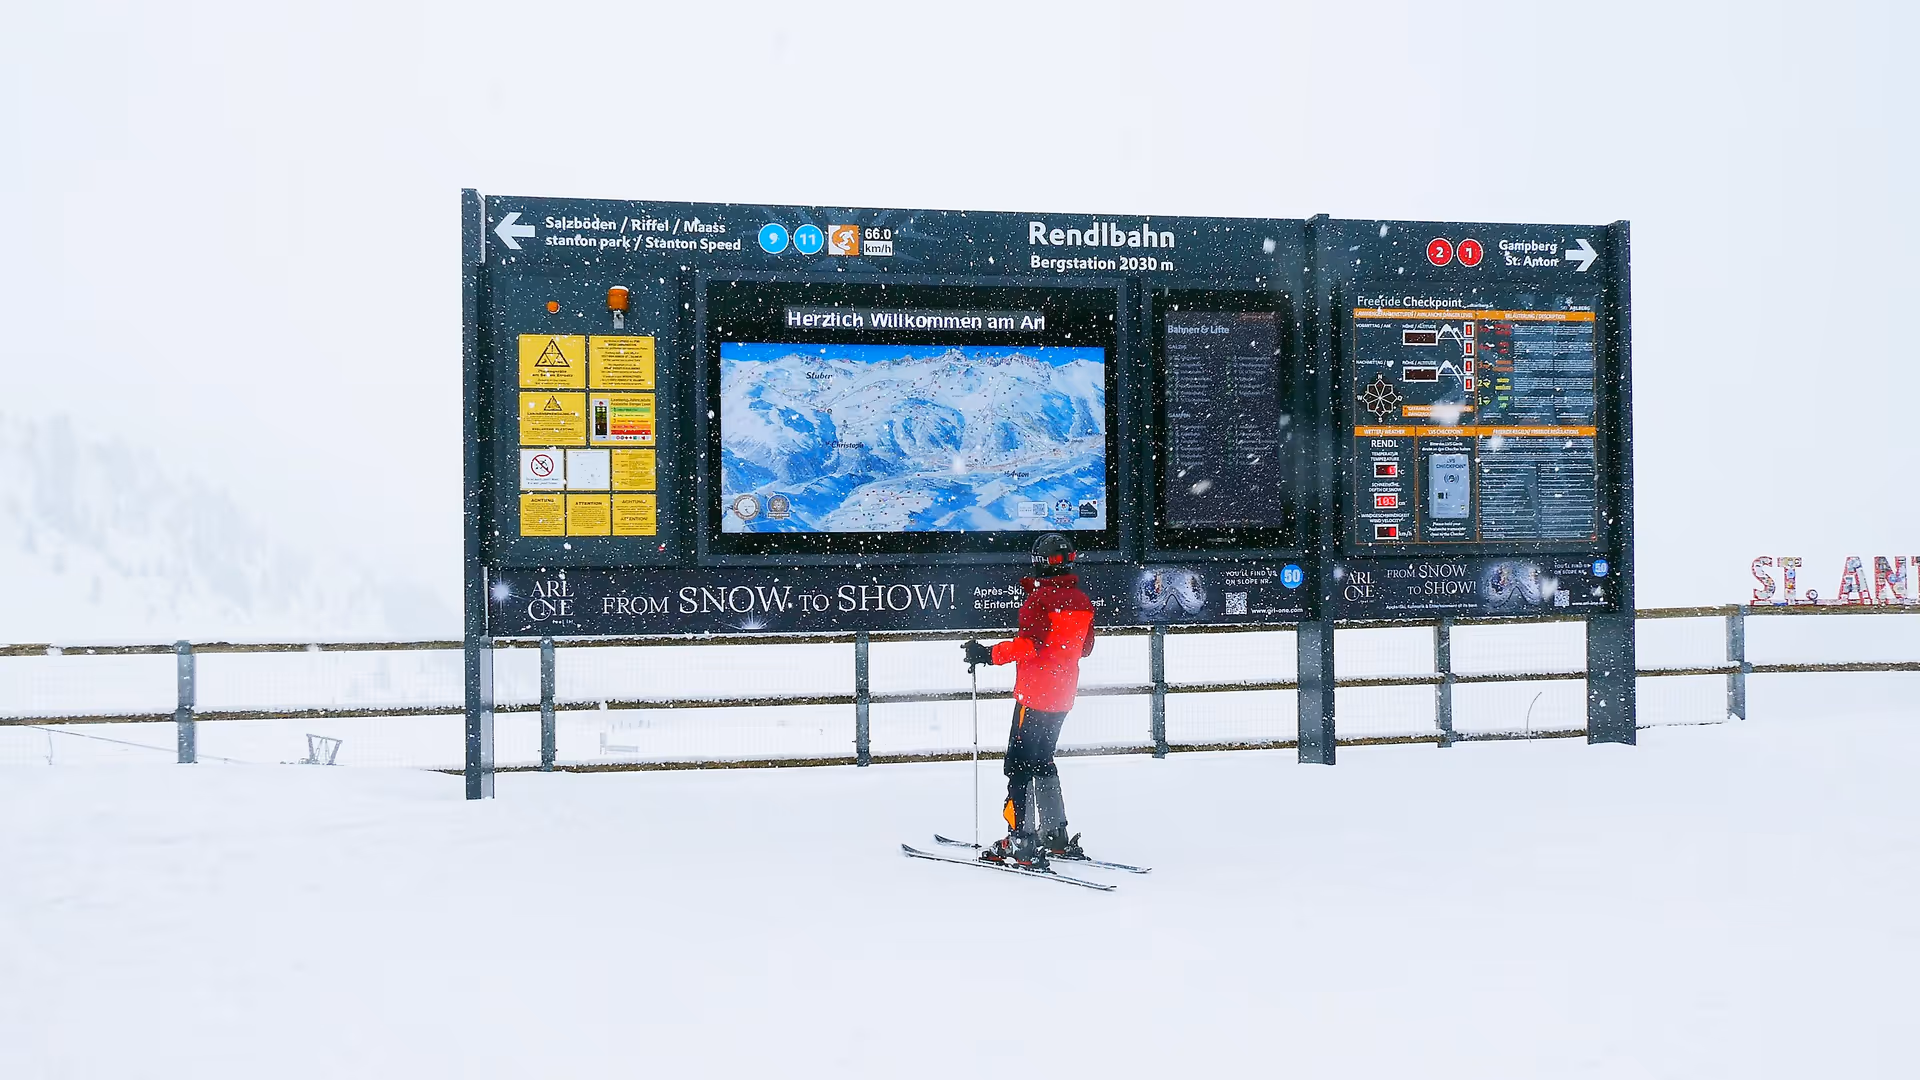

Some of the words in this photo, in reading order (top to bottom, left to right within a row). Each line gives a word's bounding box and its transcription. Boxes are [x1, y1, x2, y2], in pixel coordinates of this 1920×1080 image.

[545, 216, 617, 231] Salzböden
[631, 218, 669, 232] Riffel
[683, 219, 726, 234] Maass
[768, 231, 779, 245] 9
[799, 233, 816, 246] 11
[864, 228, 892, 240] 66.0
[1029, 221, 1175, 248] Rendlbahn
[545, 235, 597, 247] stanton
[600, 236, 631, 251] park
[645, 236, 697, 250] Stanton
[700, 239, 742, 253] Speed
[864, 243, 892, 255] km/h
[1498, 239, 1558, 255] Gampberg
[1435, 246, 1444, 258] 2
[1465, 247, 1473, 259] 1
[1030, 255, 1116, 272] Bergstation
[1119, 256, 1158, 271] 2030
[1160, 260, 1174, 271] m
[1504, 255, 1521, 267] St.
[1357, 296, 1400, 307] Freeride
[1403, 296, 1462, 309] Checkpoint
[787, 311, 864, 328] Herzlich
[870, 312, 982, 329] Willkommen
[987, 316, 1014, 330] am
[1200, 325, 1209, 334] &
[1210, 325, 1230, 334] Lifte
[1370, 440, 1399, 448] RENDL
[1377, 496, 1396, 506] 103
[1387, 569, 1415, 578] FROM
[1418, 563, 1467, 578] SNOW
[1595, 563, 1606, 573] 50
[1284, 569, 1300, 583] 50
[1346, 571, 1376, 584] ARL
[1752, 556, 1818, 603] ST.
[530, 580, 575, 598] ARL
[973, 585, 1025, 597] Après-Ski,
[1344, 585, 1375, 601] ONE
[1407, 586, 1421, 595] TO
[1424, 580, 1477, 595] SHOW!
[602, 597, 669, 614] FROM
[679, 586, 791, 614] SNOW
[798, 593, 830, 612] TO
[837, 583, 957, 612] SHOW!
[973, 600, 983, 609] &
[527, 598, 575, 621] ONE
